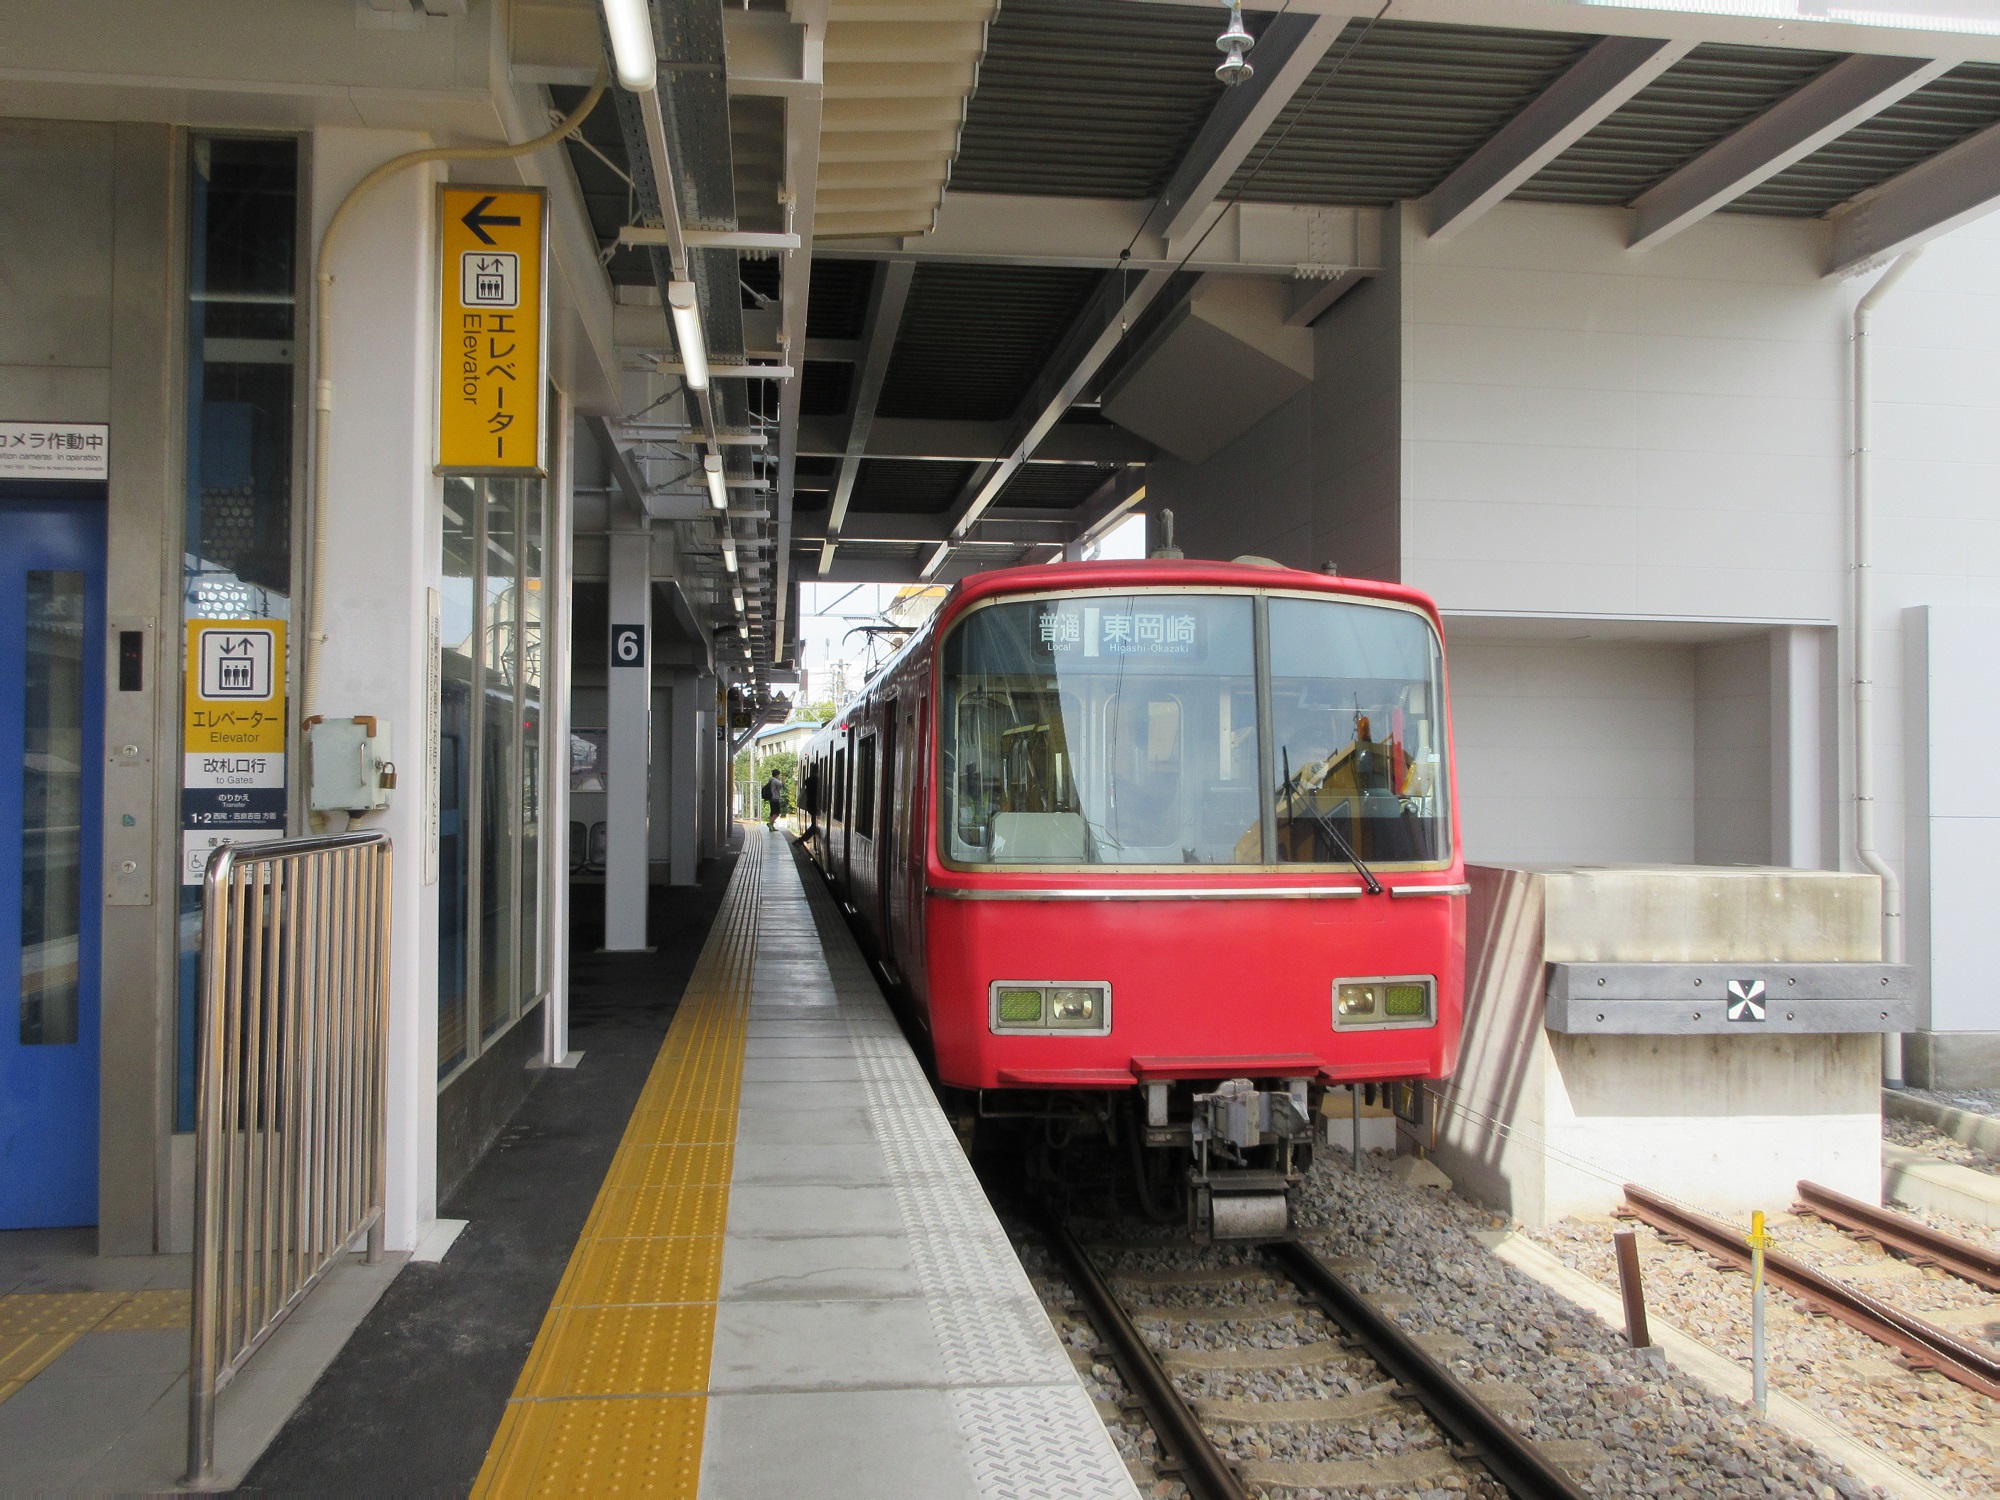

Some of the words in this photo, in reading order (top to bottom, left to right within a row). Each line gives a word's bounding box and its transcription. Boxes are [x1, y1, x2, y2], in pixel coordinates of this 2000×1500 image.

[463, 314, 482, 405] Elevator
[486, 314, 516, 458] エレベーター
[1039, 613, 1080, 642] 普通
[1102, 613, 1196, 644] 東岡崎
[617, 631, 639, 661] 6
[1047, 642, 1071, 651] Local
[1109, 643, 1189, 654] Higashi-Okazaki
[193, 711, 278, 728] エレベーター
[210, 731, 260, 743] Elevator
[203, 758, 267, 773] 改札口行
[216, 776, 225, 784] to
[227, 776, 254, 784] Gates
[218, 793, 250, 802] のりかえ
